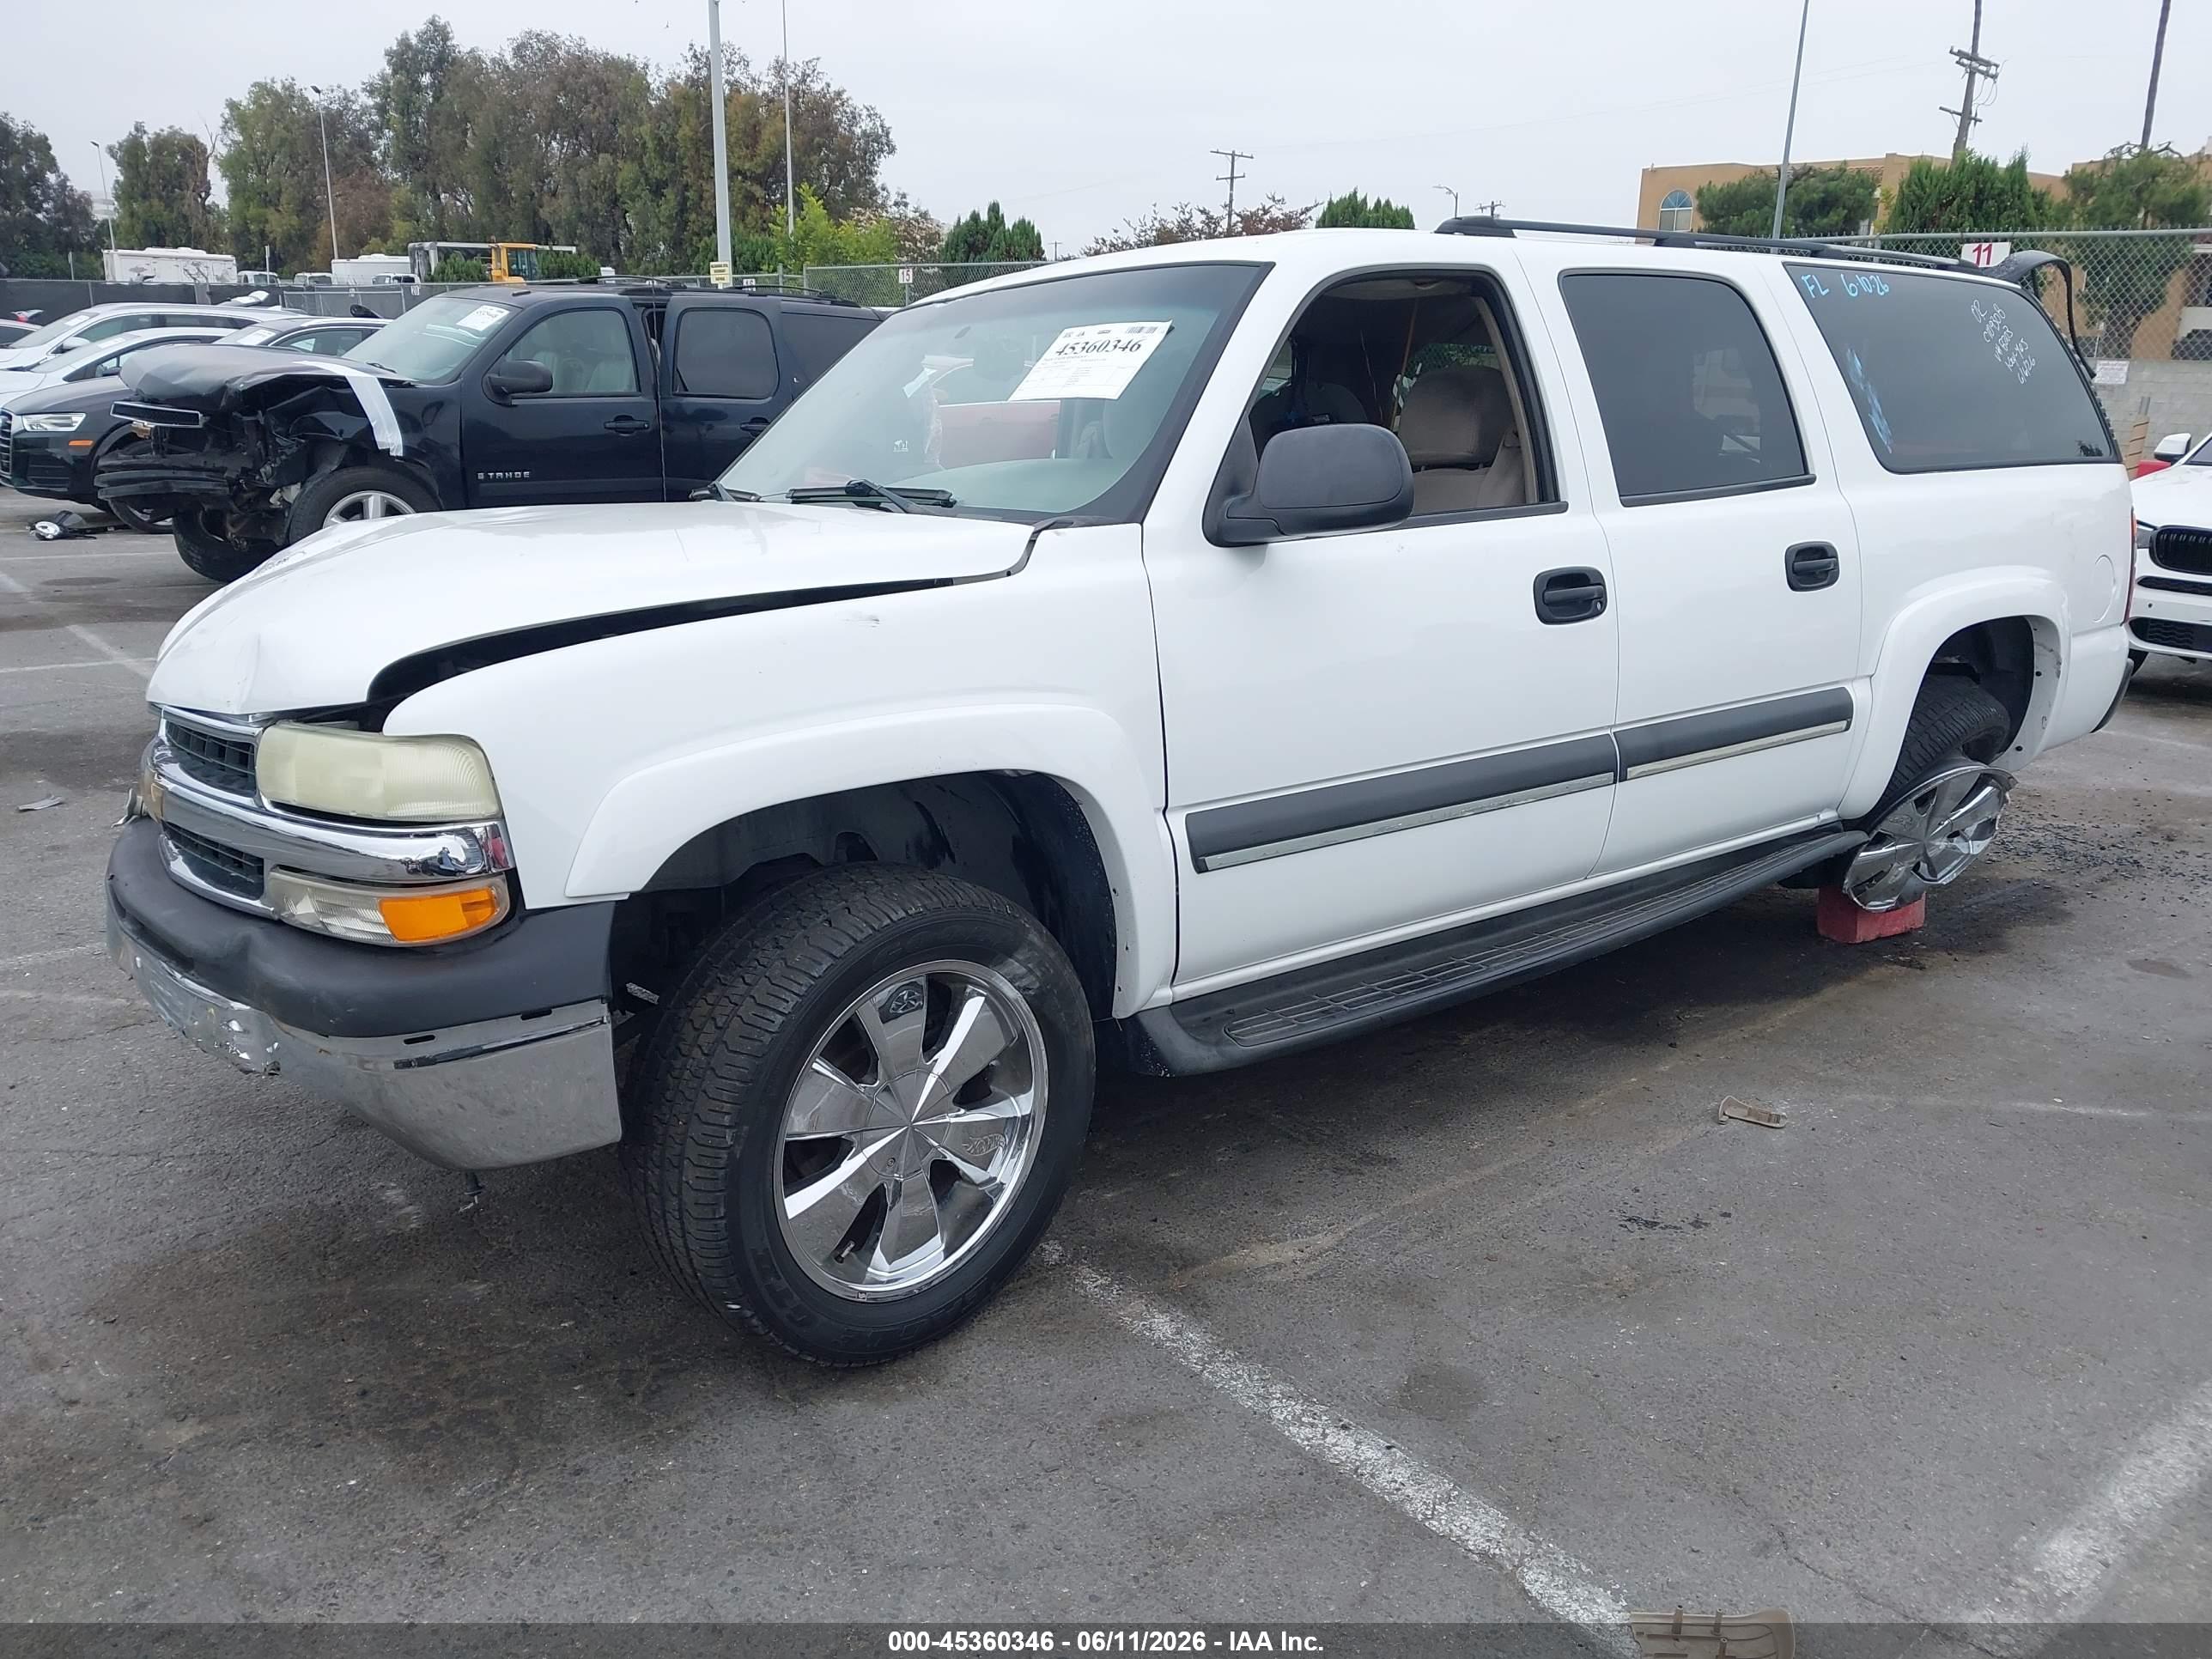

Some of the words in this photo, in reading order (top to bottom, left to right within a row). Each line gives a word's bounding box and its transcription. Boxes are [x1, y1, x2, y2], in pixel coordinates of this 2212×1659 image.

[1972, 243, 1992, 266] 11
[902, 270, 910, 283] 15
[1802, 275, 1829, 298] FL
[1055, 338, 1146, 356] 45360346
